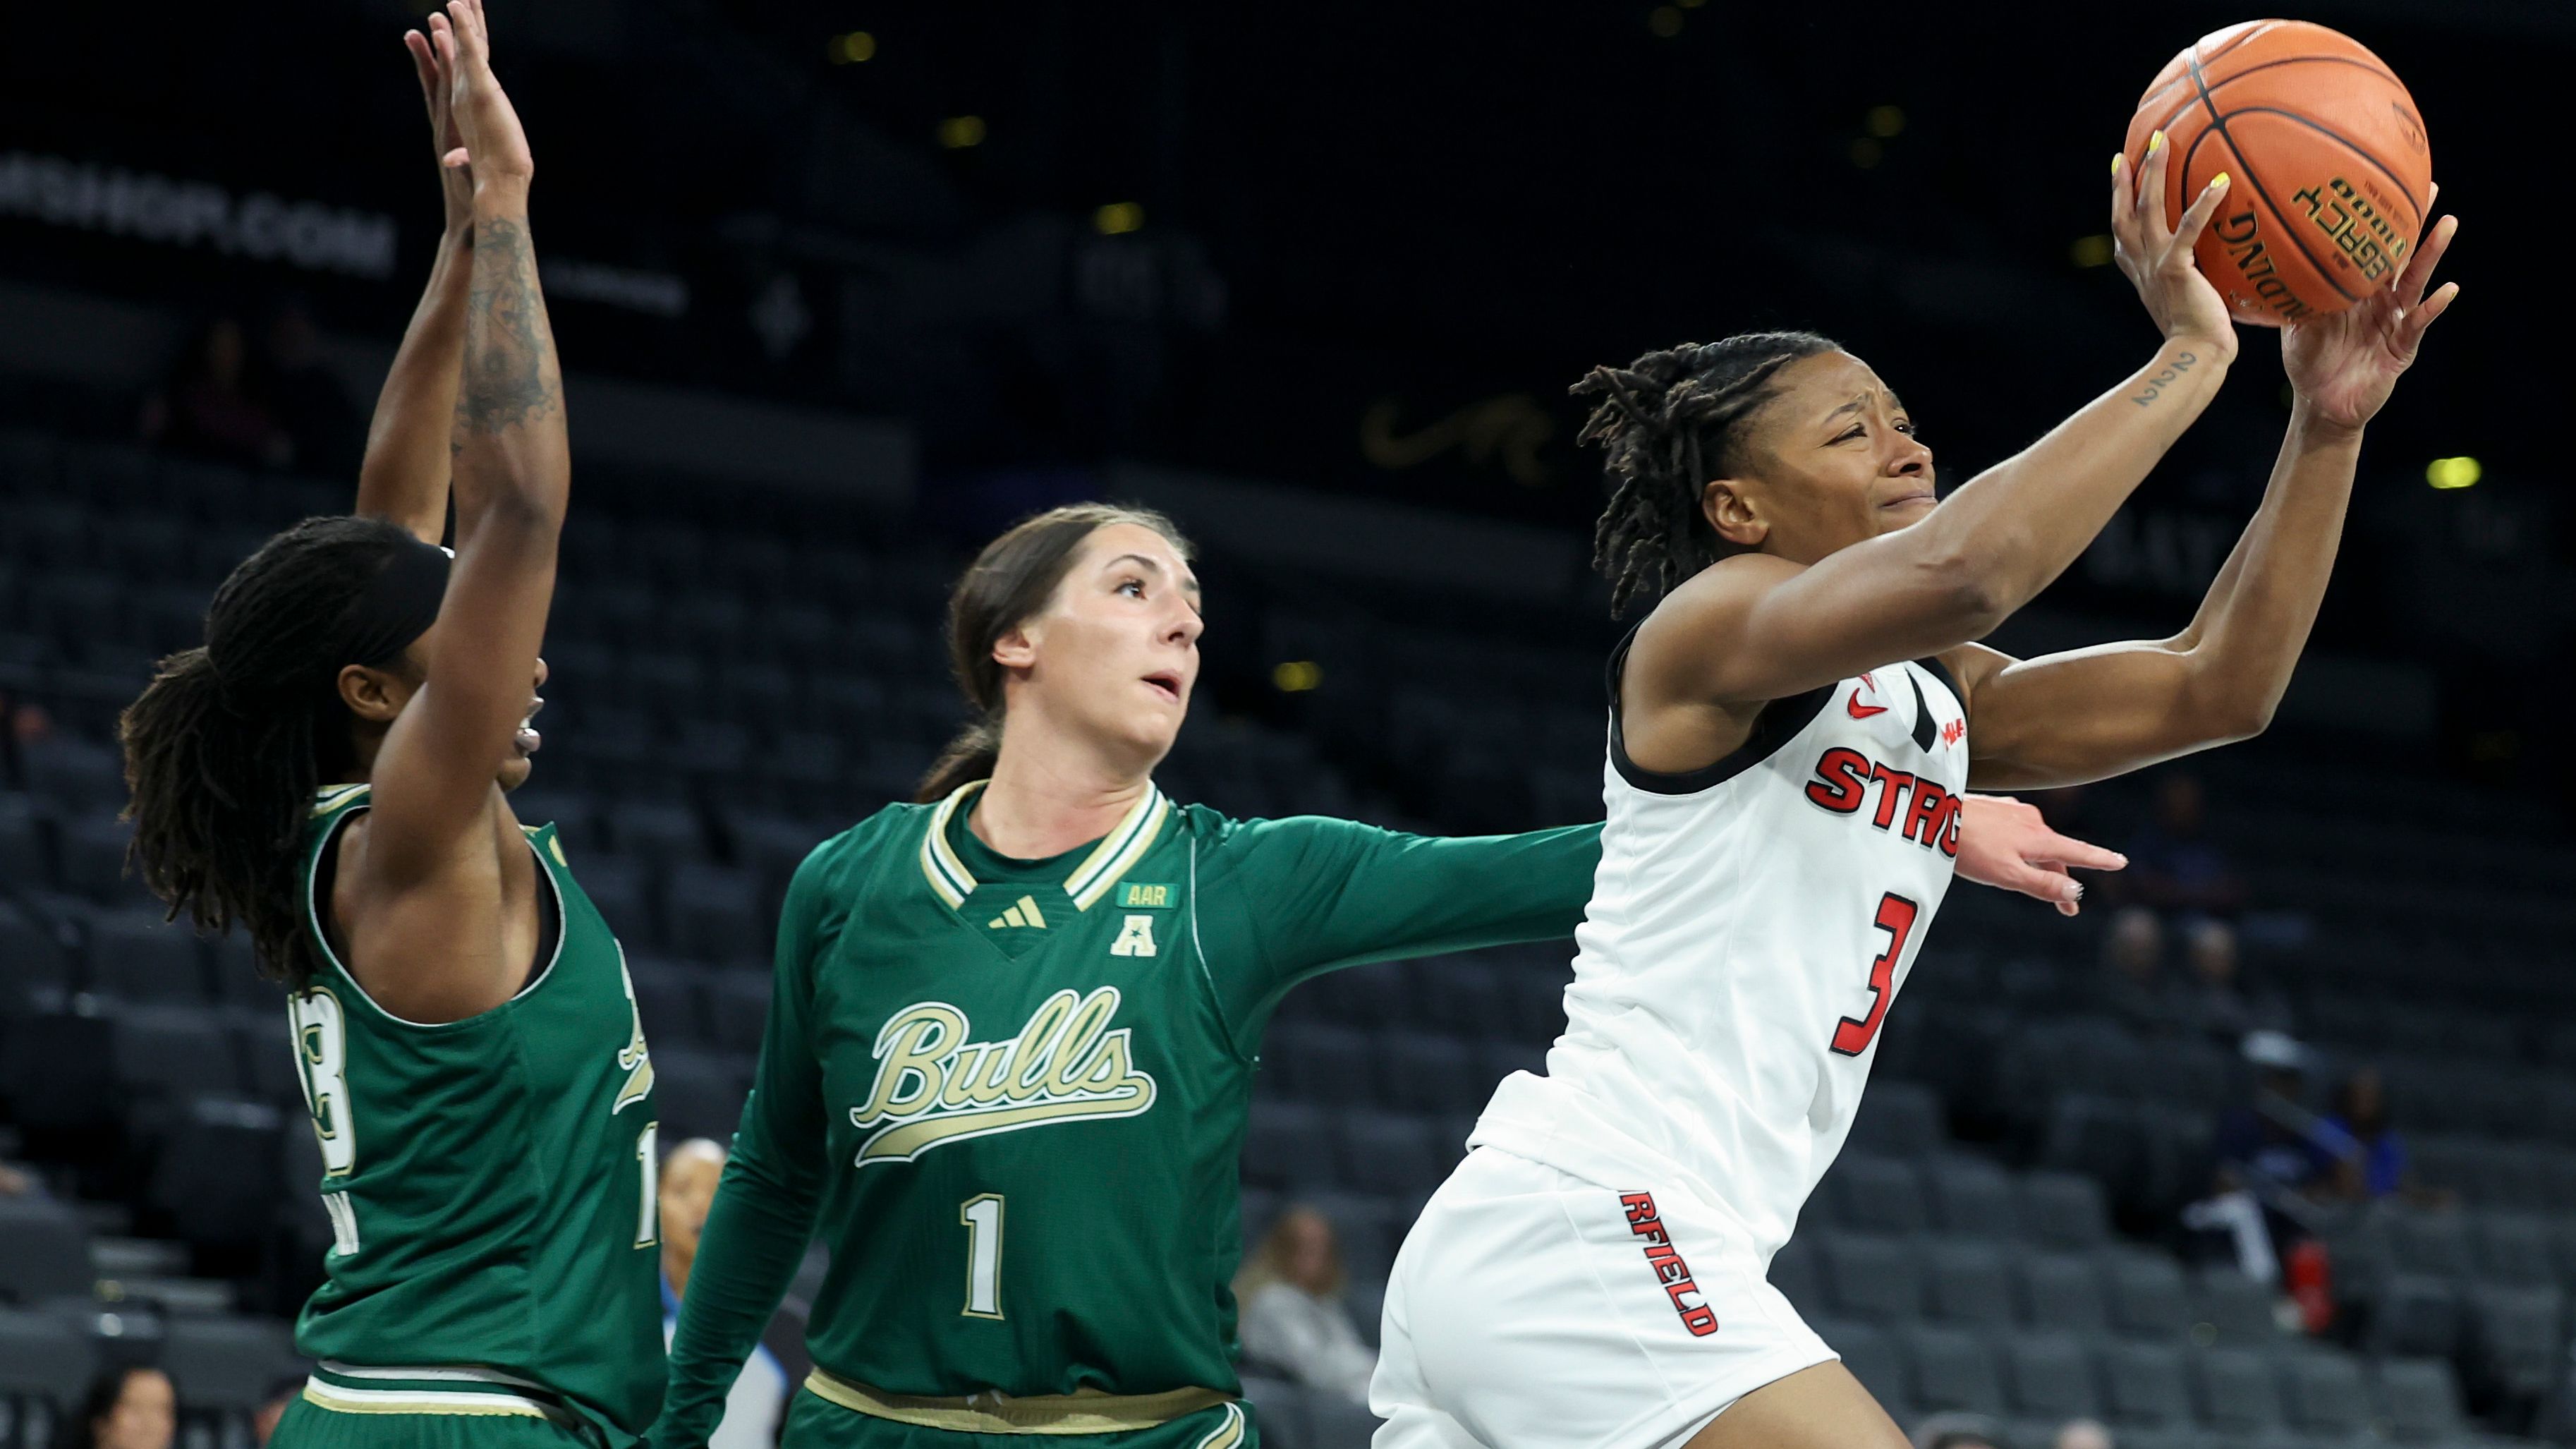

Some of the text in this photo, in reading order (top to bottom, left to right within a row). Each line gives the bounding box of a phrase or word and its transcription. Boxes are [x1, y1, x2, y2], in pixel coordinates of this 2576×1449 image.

[2291, 187, 2395, 279] EGACY
[1110, 915, 1157, 957] A
[1128, 885, 1167, 906] AAR
[1829, 891, 1918, 1057] 3
[850, 986, 1134, 1129] Bulls
[961, 1193, 1005, 1321] 1
[1618, 1190, 1718, 1337] RFIELD
